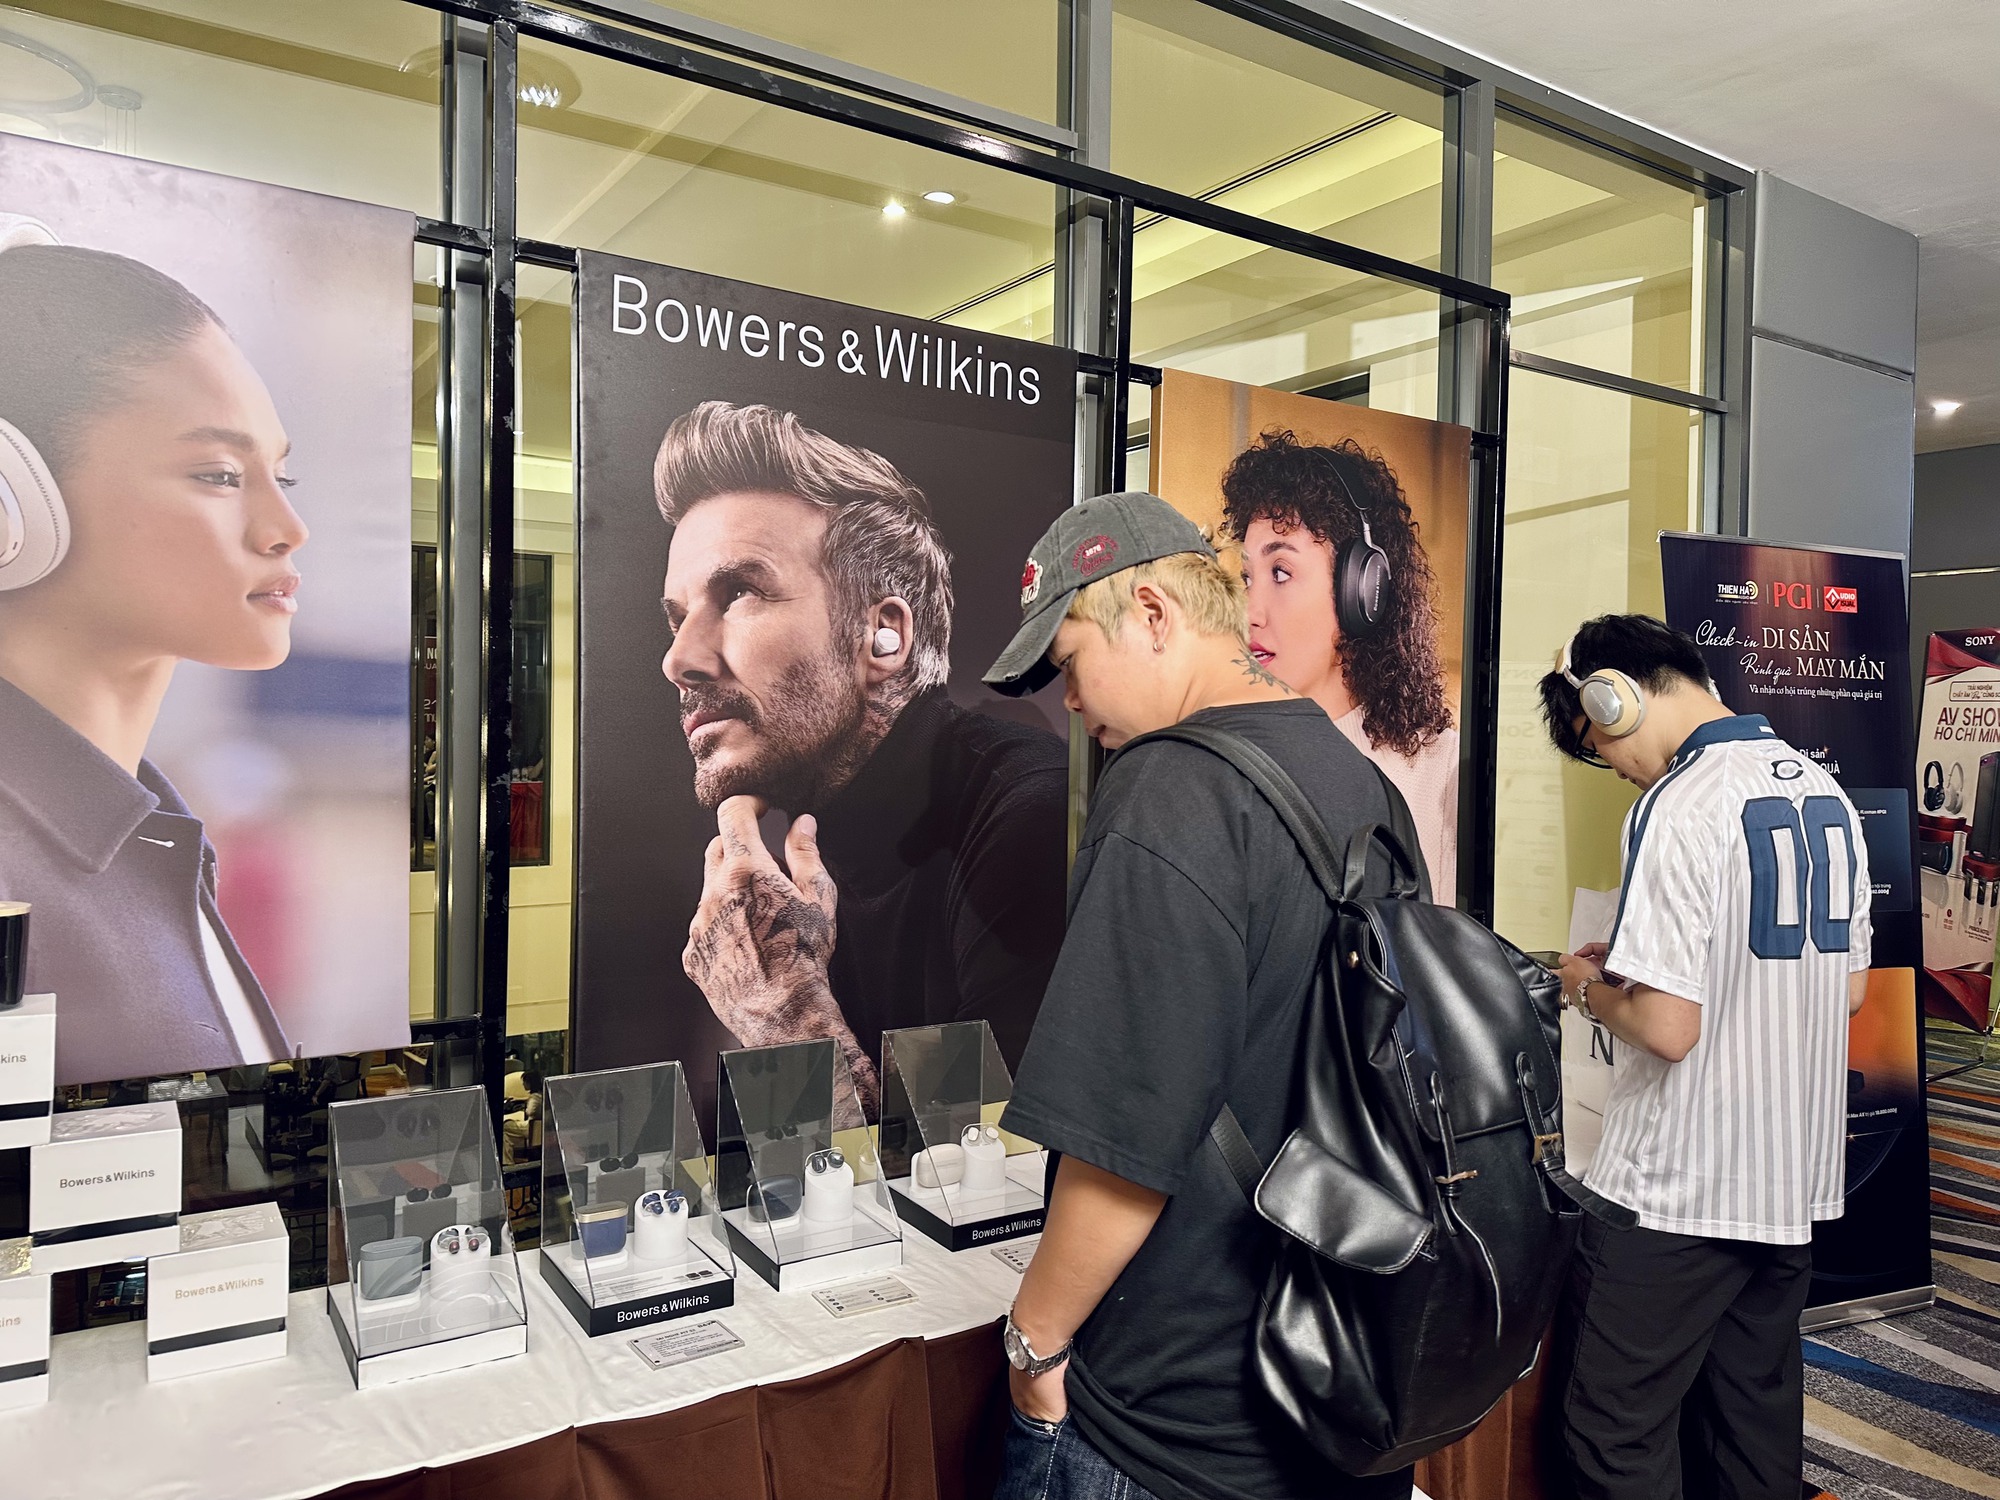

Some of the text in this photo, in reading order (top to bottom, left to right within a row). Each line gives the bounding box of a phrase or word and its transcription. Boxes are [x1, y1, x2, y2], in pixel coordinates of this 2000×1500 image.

[612, 273, 1041, 406] Bowers & Wilkins
[1773, 582, 1812, 610] PGI
[1762, 626, 1786, 650] DI
[1789, 624, 1830, 652] SẢN
[1964, 636, 1996, 646] SONY
[1740, 652, 1886, 685] Rinh quà MAY MẮN
[1749, 684, 1758, 694] Và
[1797, 688, 1816, 698] trúng
[1937, 707, 1959, 726] AV
[1978, 728, 2000, 742] MIN
[1810, 748, 1826, 759] sản
[0, 1053, 26, 1064] kins
[60, 1174, 104, 1189] Bowers
[114, 1168, 155, 1181] Wilkins
[972, 1226, 1004, 1240] Bowers
[1011, 1218, 1042, 1231] Wilkins
[175, 1286, 216, 1299] Bowers
[225, 1276, 264, 1290] Wilkins
[617, 1295, 710, 1322] Bowers & Wilkins
[0, 1316, 21, 1328] ins
